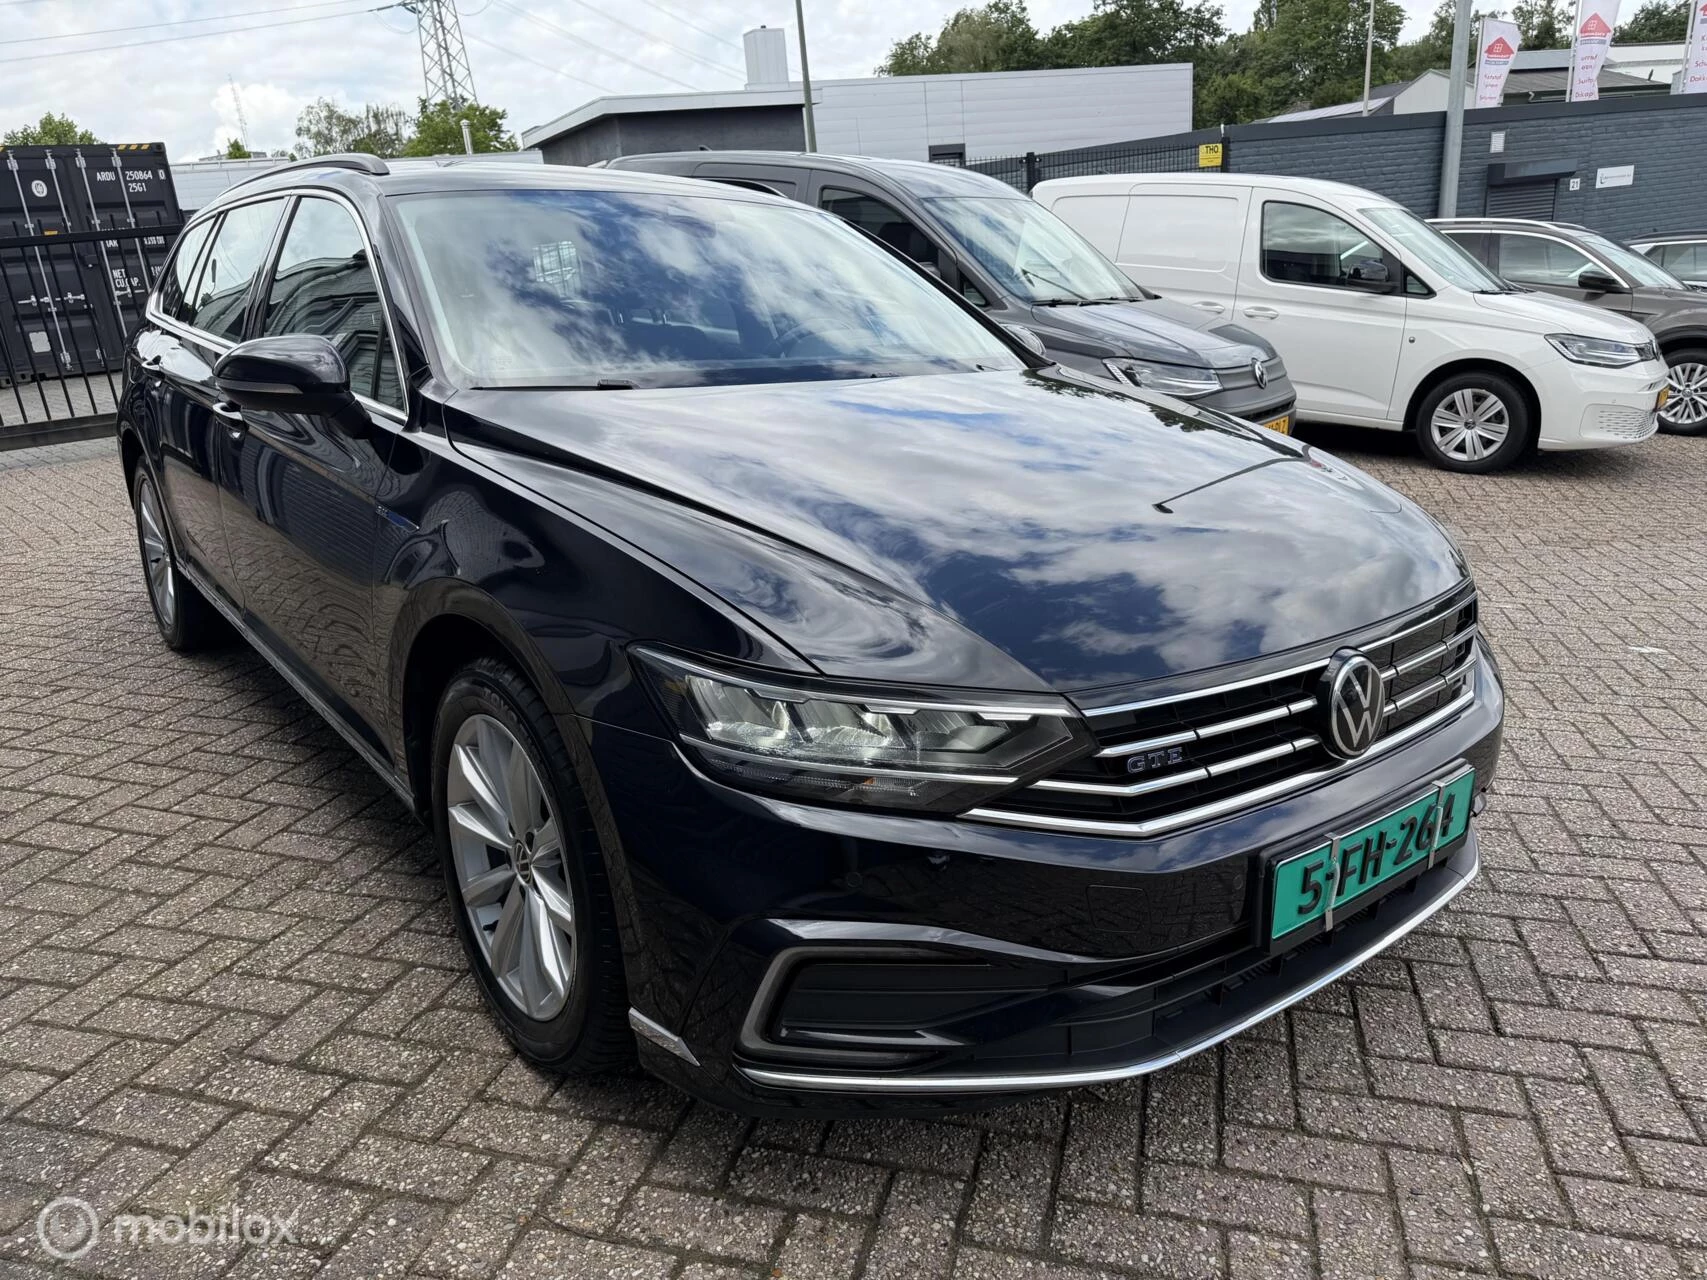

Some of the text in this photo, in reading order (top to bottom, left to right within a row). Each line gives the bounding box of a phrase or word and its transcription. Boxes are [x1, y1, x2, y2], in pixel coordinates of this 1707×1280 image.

[96, 171, 116, 181] ARDU
[125, 170, 153, 180] 250864
[128, 182, 147, 192] 25G1
[1571, 181, 1579, 189] 21
[112, 268, 126, 279] NET
[1127, 746, 1183, 774] GTE
